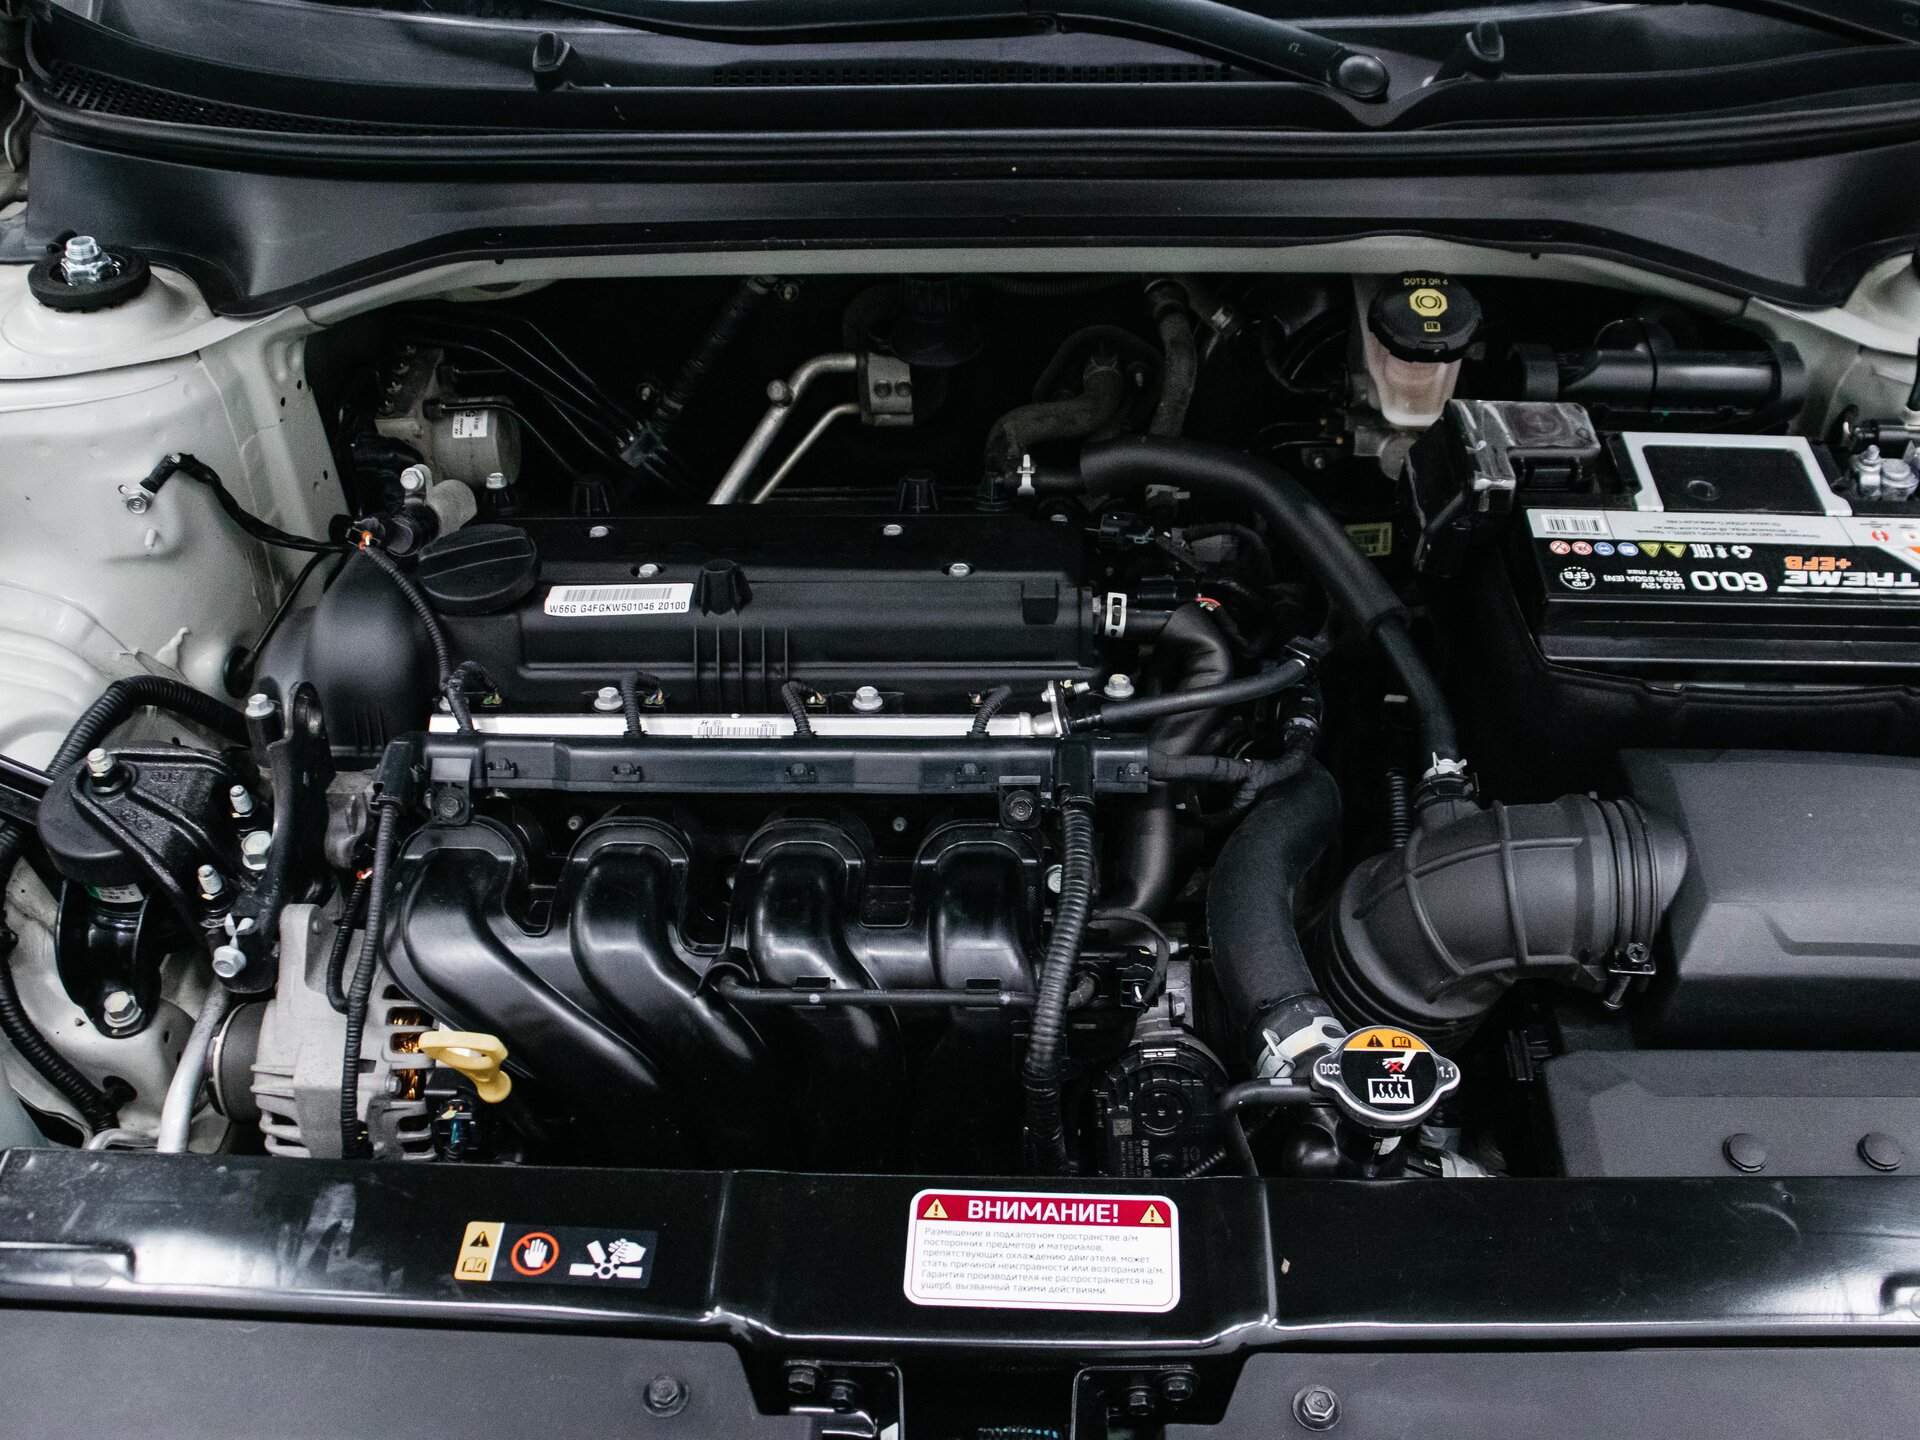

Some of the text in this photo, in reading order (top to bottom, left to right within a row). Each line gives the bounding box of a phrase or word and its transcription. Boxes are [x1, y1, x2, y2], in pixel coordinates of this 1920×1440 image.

[1784, 556, 1851, 570] +EFB
[1565, 571, 1590, 579] EFB
[1690, 570, 1768, 592] 60.0
[550, 604, 576, 613] W66G
[658, 601, 686, 610] 20100
[1438, 1066, 1454, 1078] 1.1
[968, 1200, 1118, 1223] ВНИМАНИЕ!
[925, 1227, 983, 1237] Размещение
[923, 1250, 1002, 1259] препятствующих
[1091, 1266, 1144, 1274] возгорания
[922, 1270, 964, 1278] Гарантия
[967, 1272, 1038, 1281] производителя
[1056, 1276, 1140, 1284] распространяется
[956, 1282, 1010, 1291] вызванный
